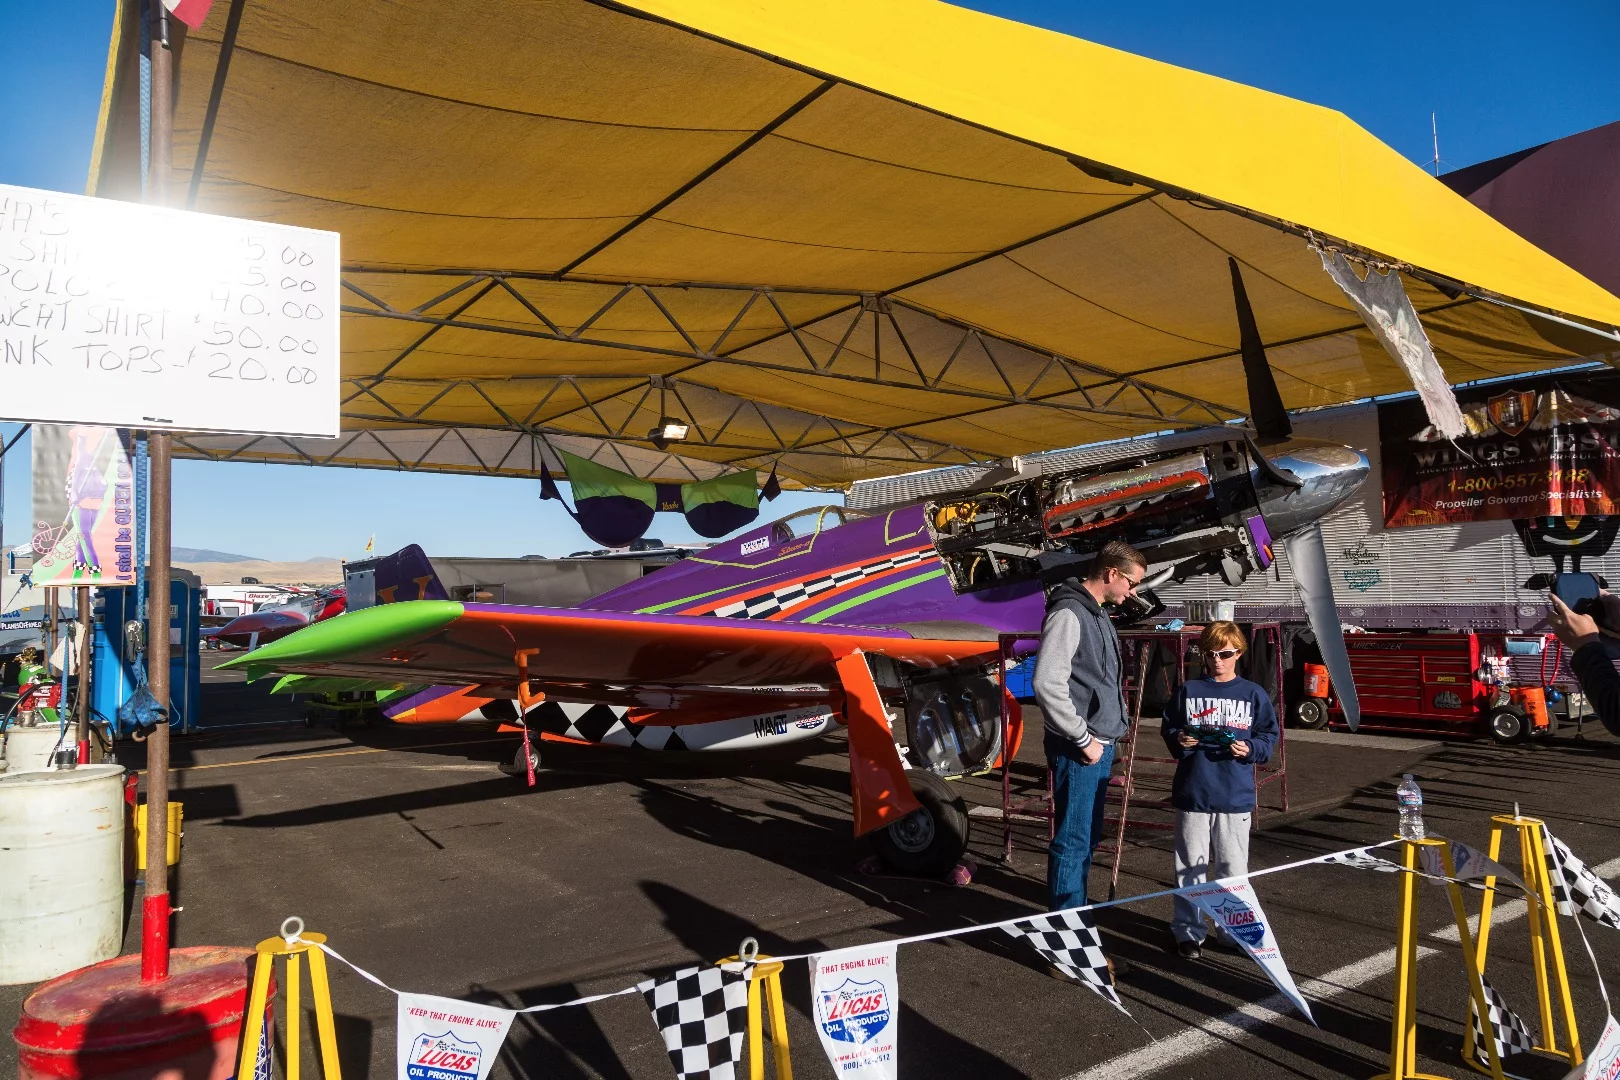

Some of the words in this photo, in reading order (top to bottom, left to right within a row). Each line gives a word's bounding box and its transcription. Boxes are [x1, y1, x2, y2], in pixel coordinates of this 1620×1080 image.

[85, 304, 171, 341] SHIRT
[0, 334, 54, 367] NK
[1413, 440, 1521, 469] WINGS
[1447, 468, 1591, 494] 1-800-557-3188
[115, 482, 131, 525] QUEEN
[1435, 497, 1485, 510] Propeller
[1487, 493, 1539, 506] Governor
[1540, 489, 1603, 502] Specialists
[115, 527, 131, 543] be
[115, 545, 131, 573] shall
[1185, 697, 1252, 721] NATIONAL
[1224, 910, 1255, 926] LUCAS
[821, 964, 838, 975] THAT
[840, 959, 866, 971] ENGINE
[429, 1011, 448, 1021] THAT
[448, 1014, 475, 1026] ENGINE
[828, 993, 883, 1021] LUCAS
[826, 1023, 842, 1034] OIL
[416, 1049, 477, 1071] LUCAS
[409, 1067, 425, 1077] OIL
